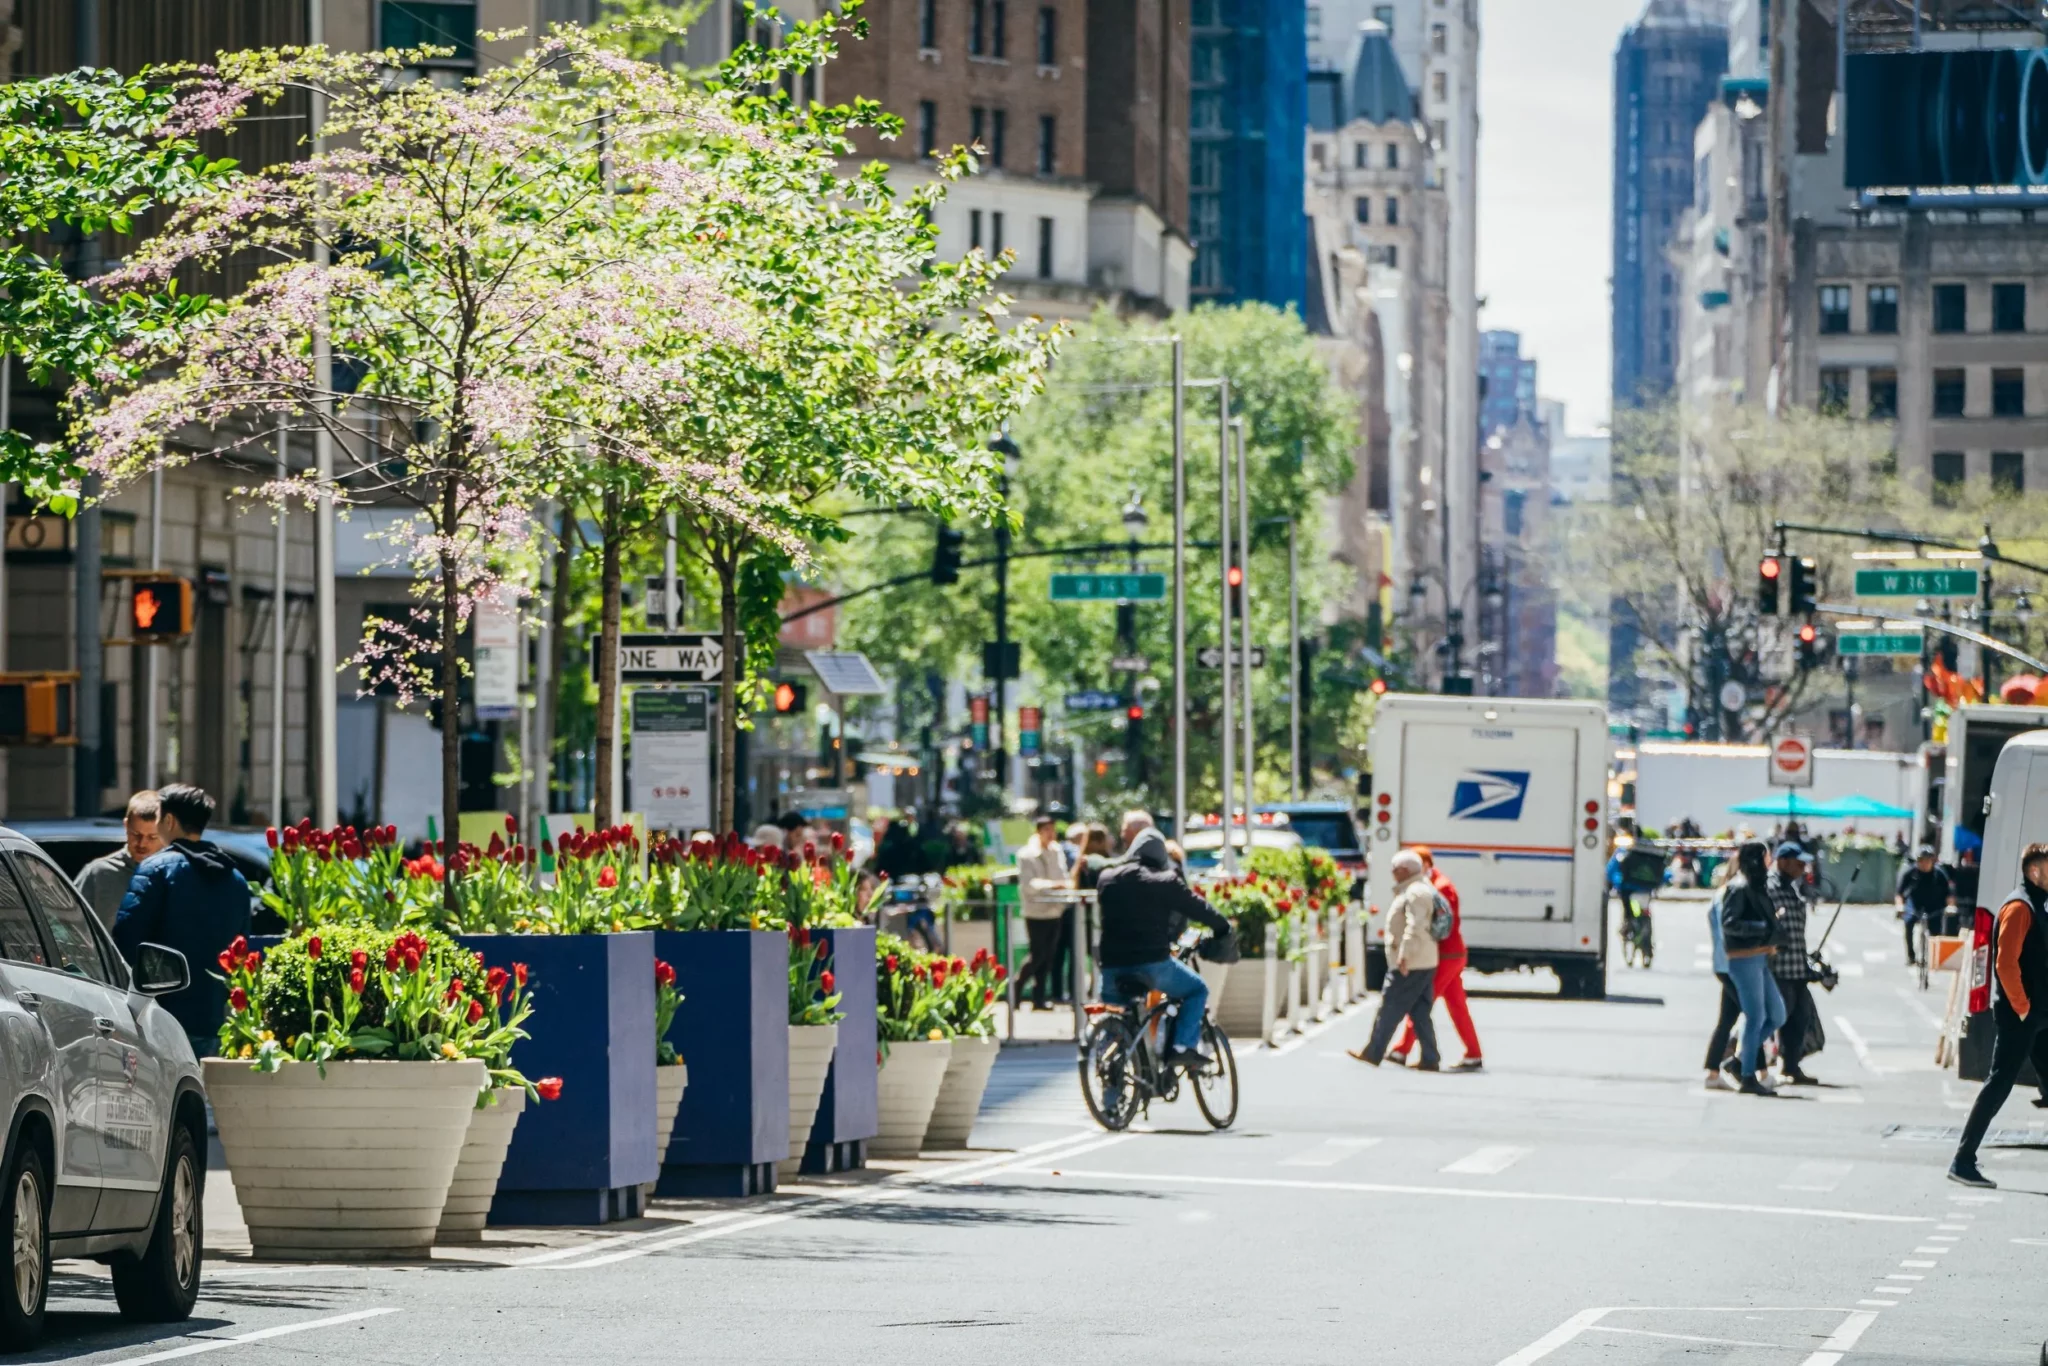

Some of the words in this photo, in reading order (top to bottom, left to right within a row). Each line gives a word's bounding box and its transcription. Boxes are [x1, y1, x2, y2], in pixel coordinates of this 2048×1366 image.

[1883, 575, 1899, 591] W
[1907, 575, 1926, 592] 36
[677, 650, 723, 669] WAY
